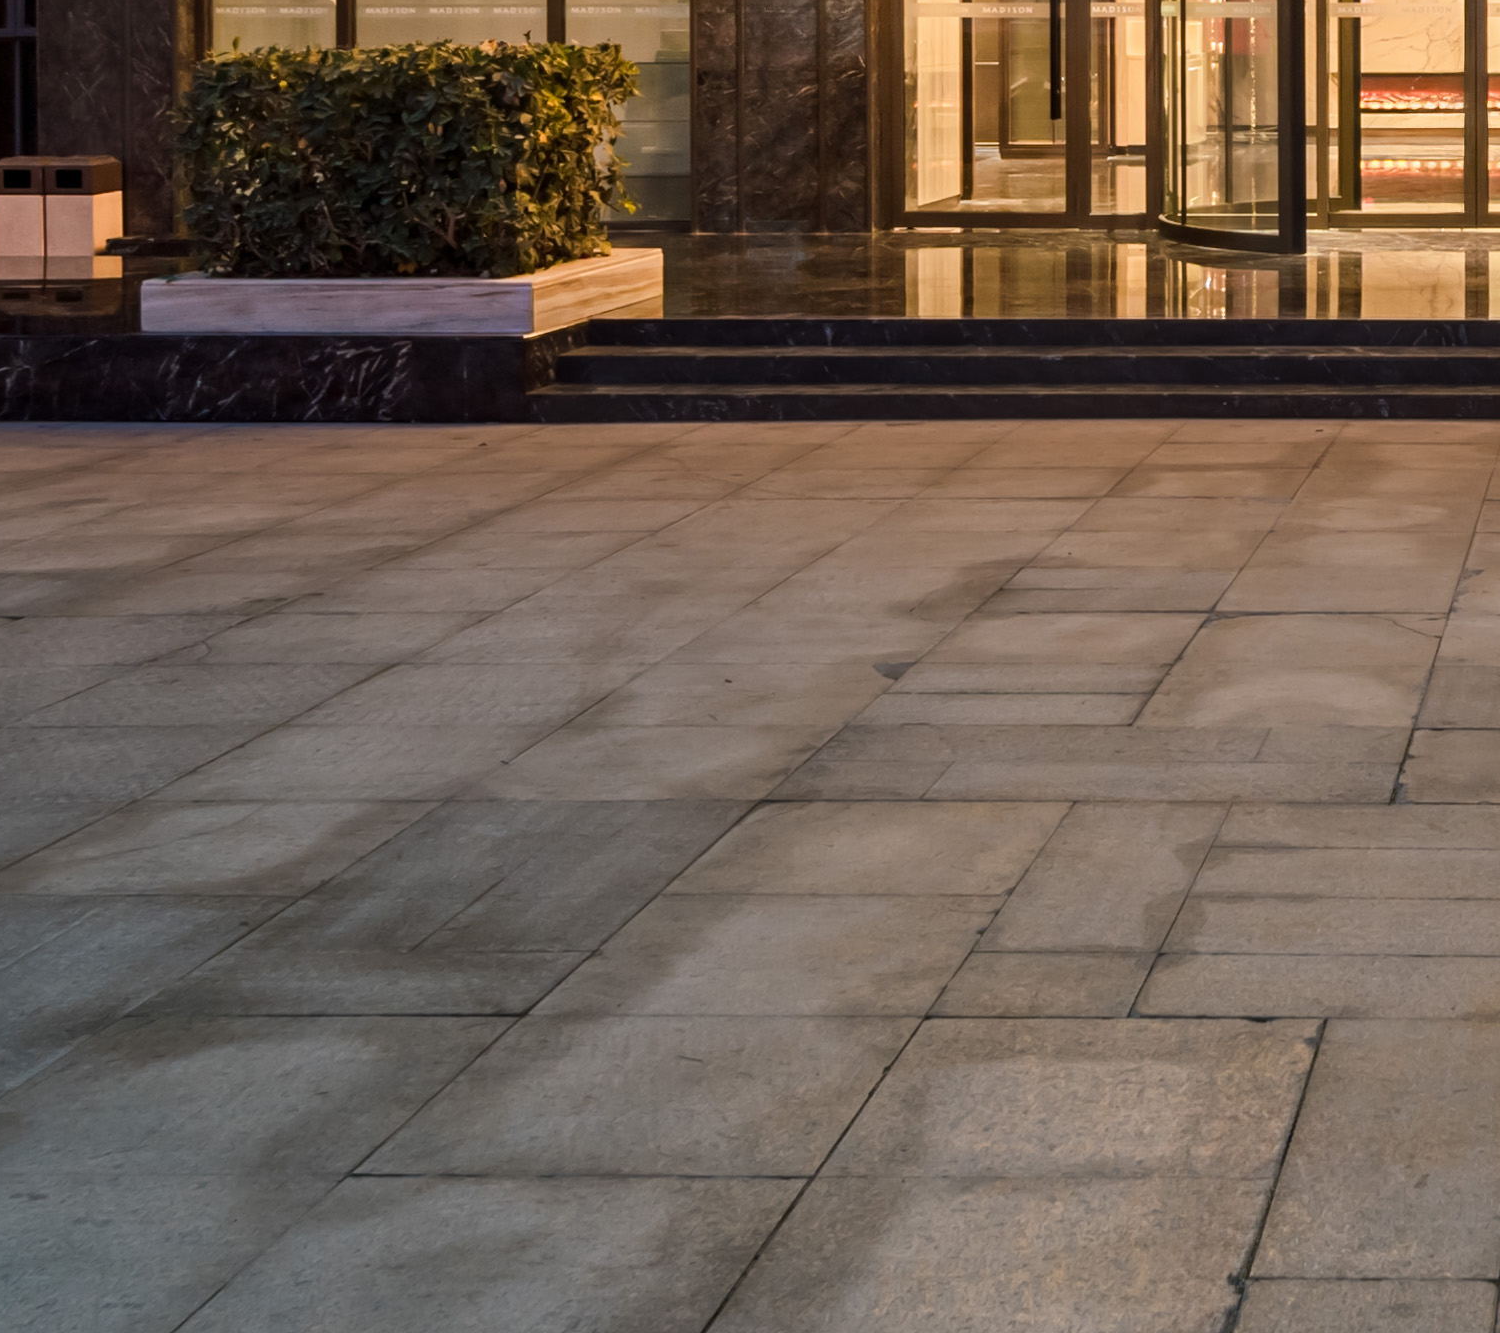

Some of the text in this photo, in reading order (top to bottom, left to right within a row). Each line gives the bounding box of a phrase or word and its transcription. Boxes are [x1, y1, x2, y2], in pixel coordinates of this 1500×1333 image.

[365, 6, 417, 15] MADISON
[429, 6, 481, 15] MADISON
[982, 6, 1034, 15] MADISON
